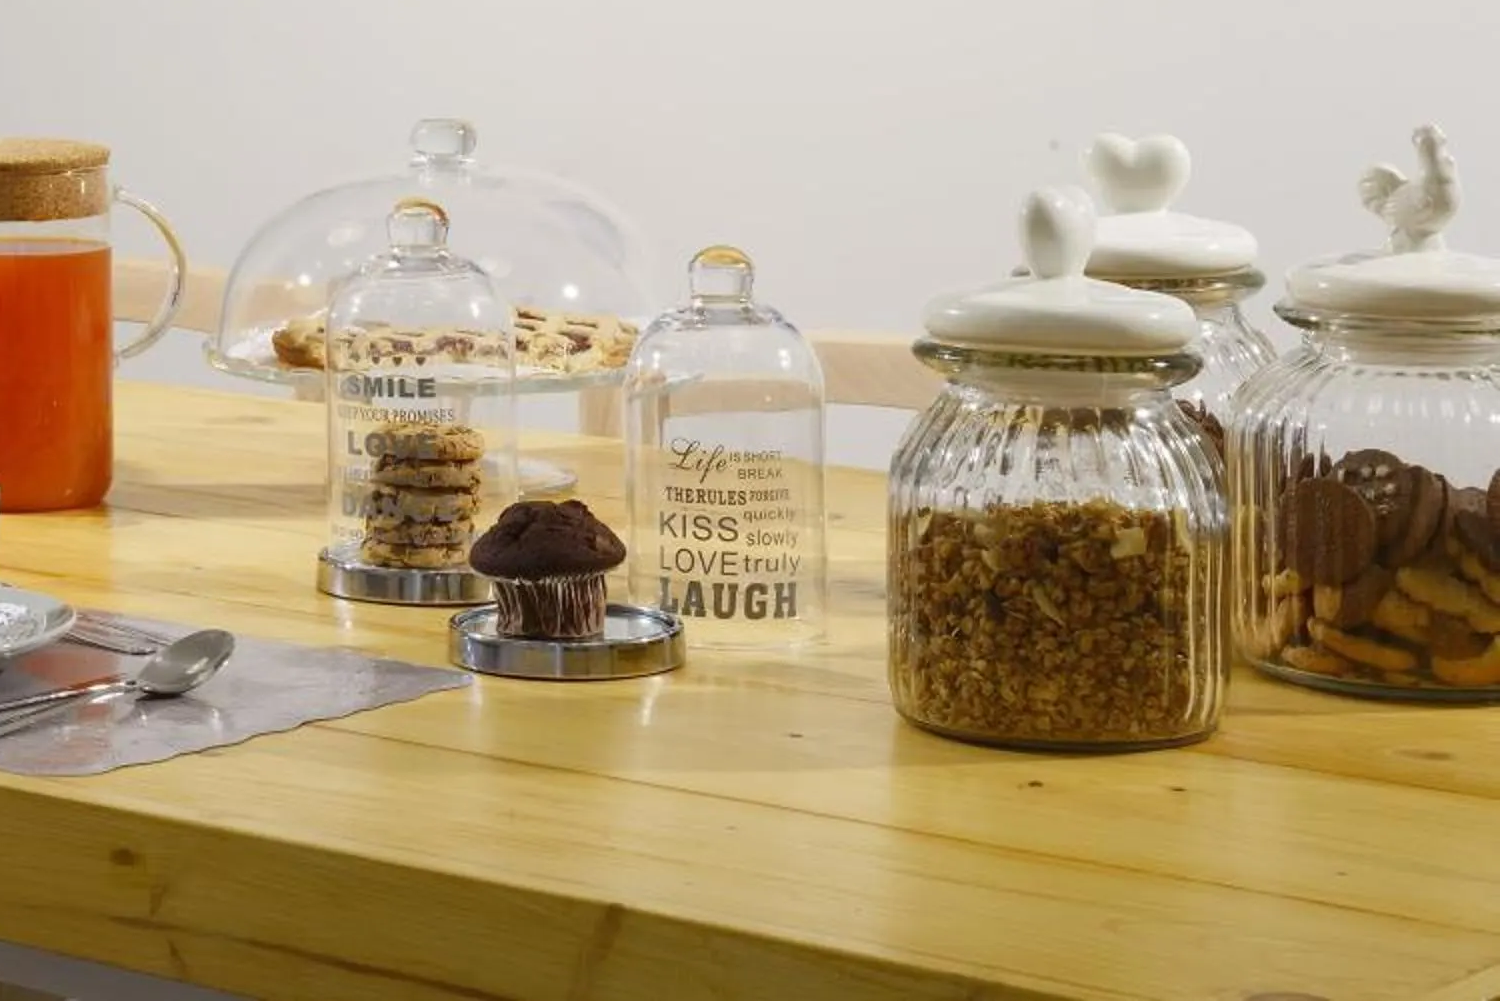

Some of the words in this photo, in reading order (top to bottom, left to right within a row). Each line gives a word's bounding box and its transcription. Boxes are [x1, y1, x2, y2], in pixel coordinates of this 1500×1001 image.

[344, 375, 437, 399] SMILE
[392, 407, 454, 424] PROMISES
[668, 437, 730, 484] Life
[729, 452, 741, 463] IS
[743, 450, 783, 463] SHORT
[737, 468, 783, 480] BREAK
[659, 511, 739, 542] KISS
[743, 507, 796, 524] quickly
[746, 529, 799, 548] slowly
[659, 545, 739, 576] LOVE
[743, 552, 800, 576] truly
[659, 577, 798, 620] LAUGH
